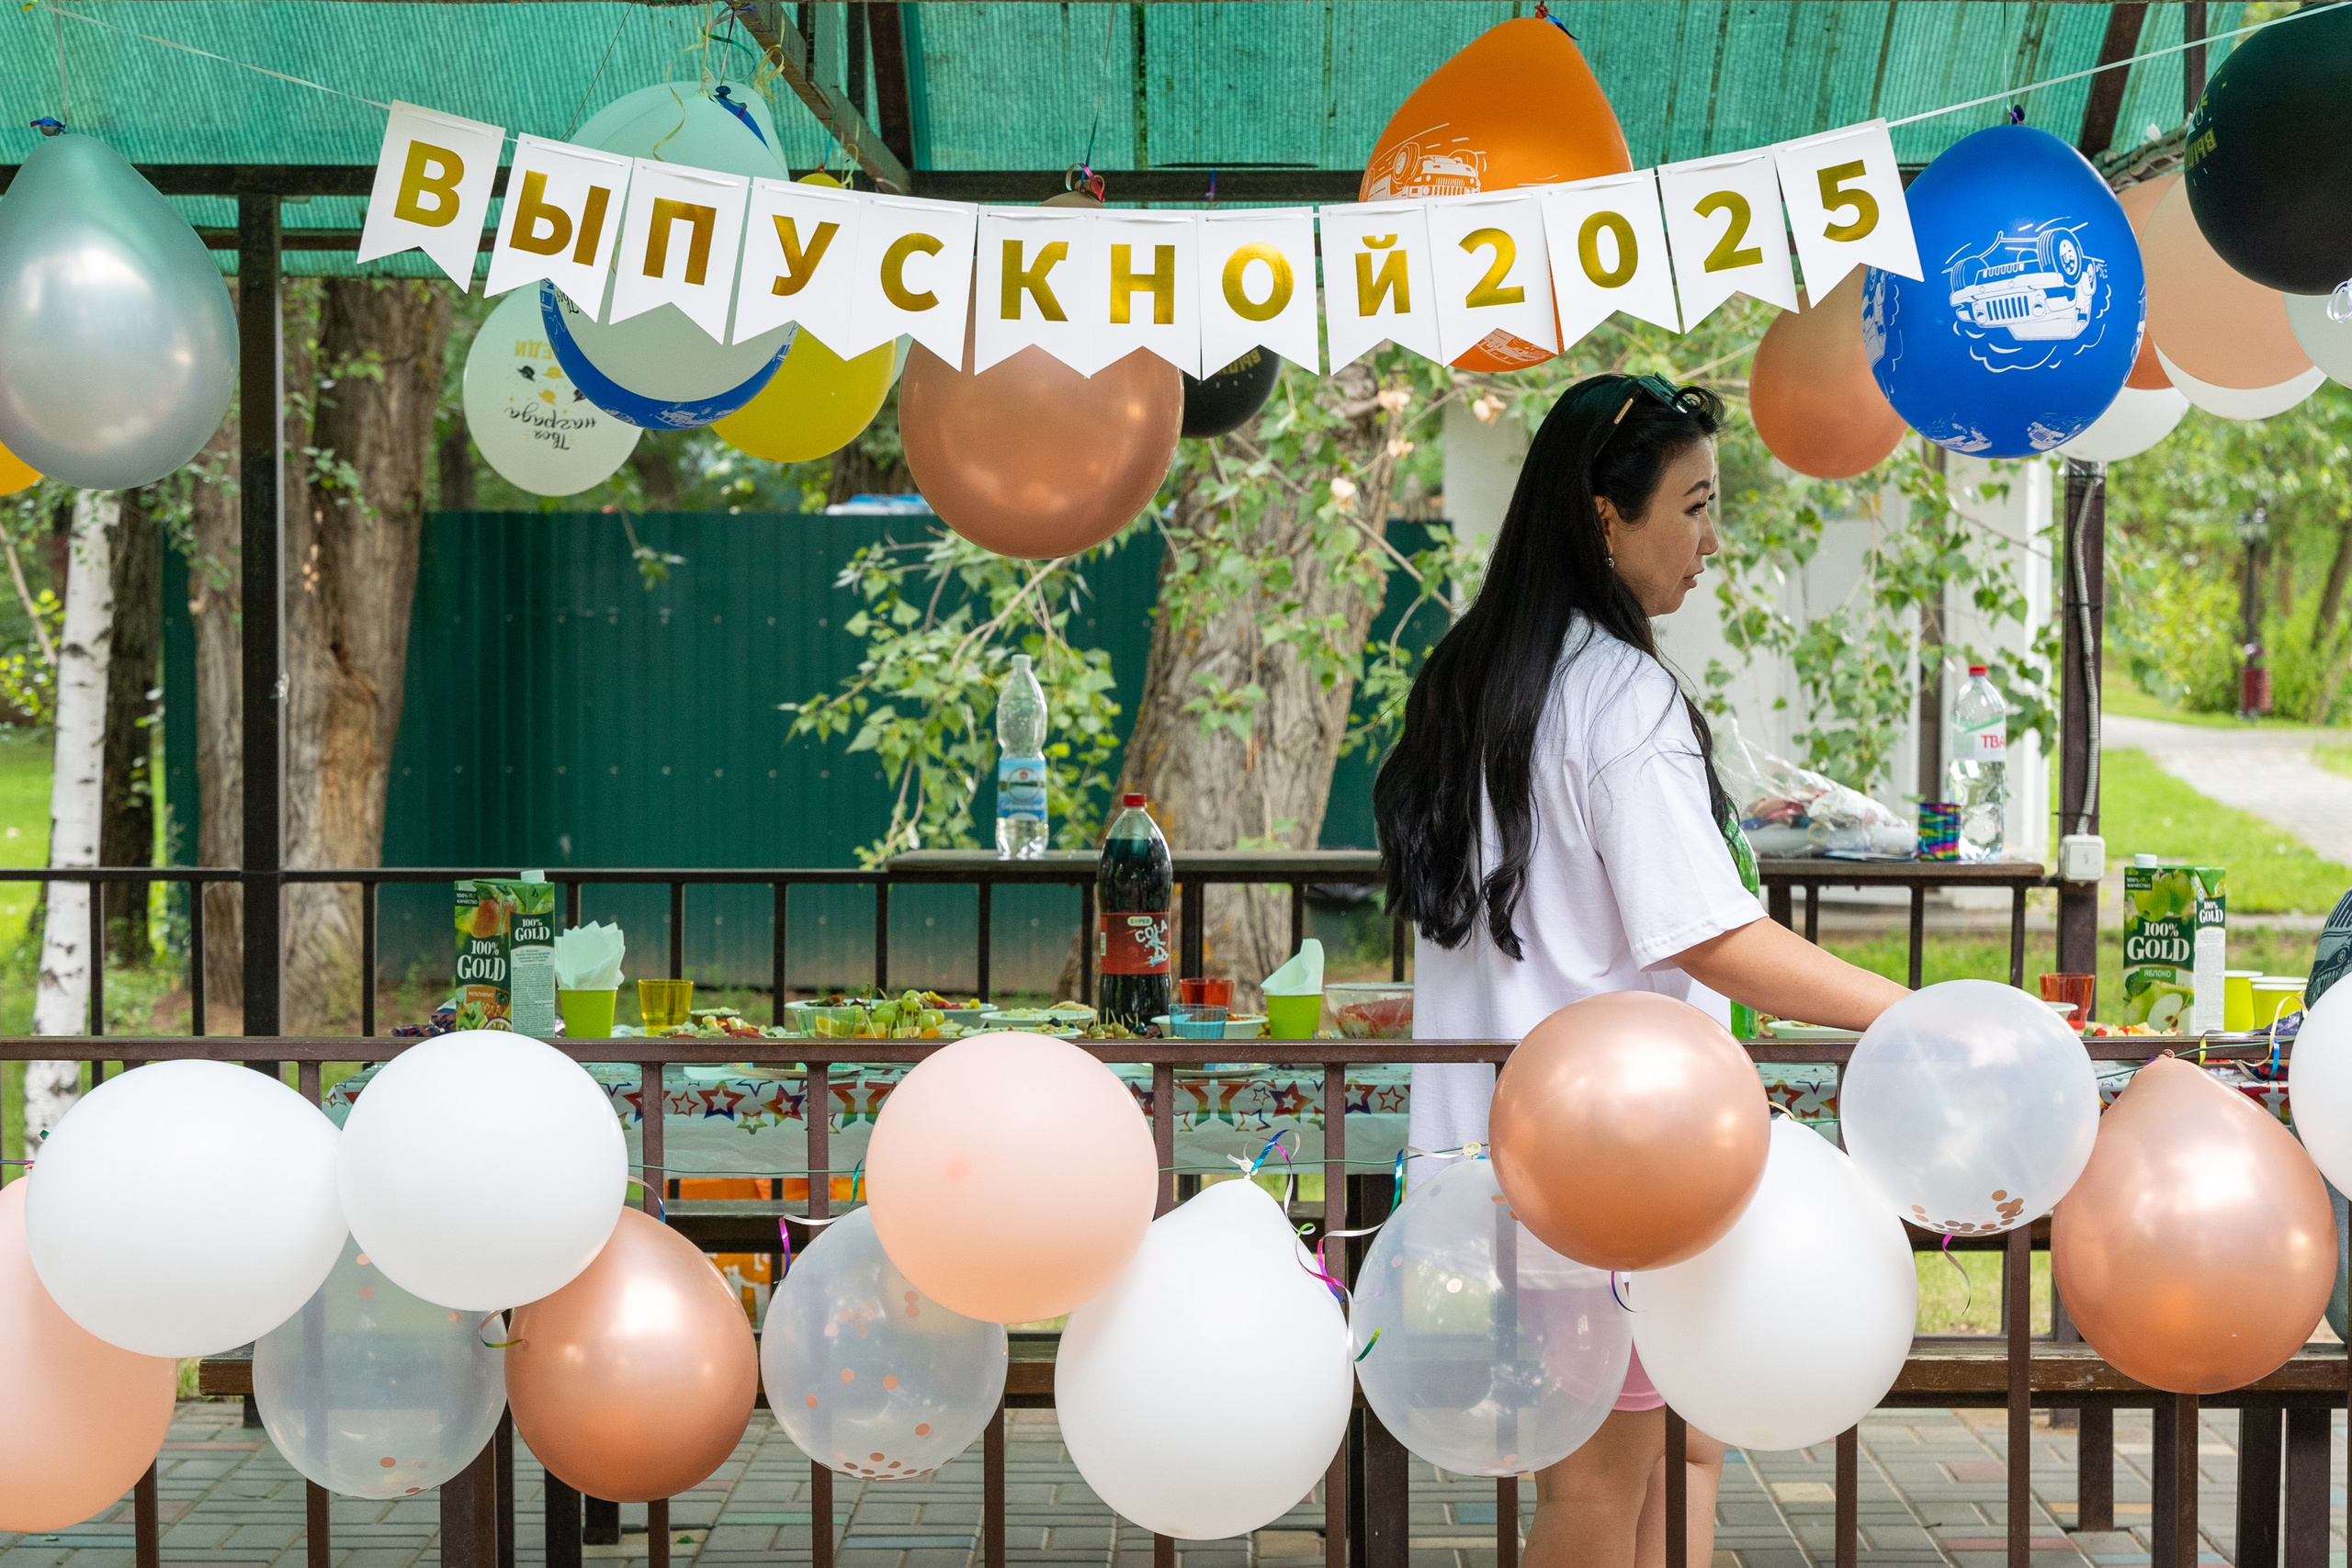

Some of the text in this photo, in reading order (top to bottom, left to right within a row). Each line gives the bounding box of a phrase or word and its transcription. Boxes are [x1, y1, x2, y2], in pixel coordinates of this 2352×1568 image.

[393, 139, 1880, 325] ВЫПУСКНОЙ 2025
[504, 401, 597, 430] награда
[532, 430, 571, 451] Твоя
[2203, 901, 2219, 909] 100%
[522, 919, 543, 928] 100%
[2199, 908, 2223, 923] GOLD
[514, 927, 550, 942] GOLD
[1135, 919, 1169, 943] COLA
[2143, 921, 2179, 938] 100%
[470, 940, 500, 956] 100%
[2127, 935, 2190, 963] GOLD
[457, 954, 506, 982] GOLD
[2143, 969, 2172, 978] ЯБЛОКО
